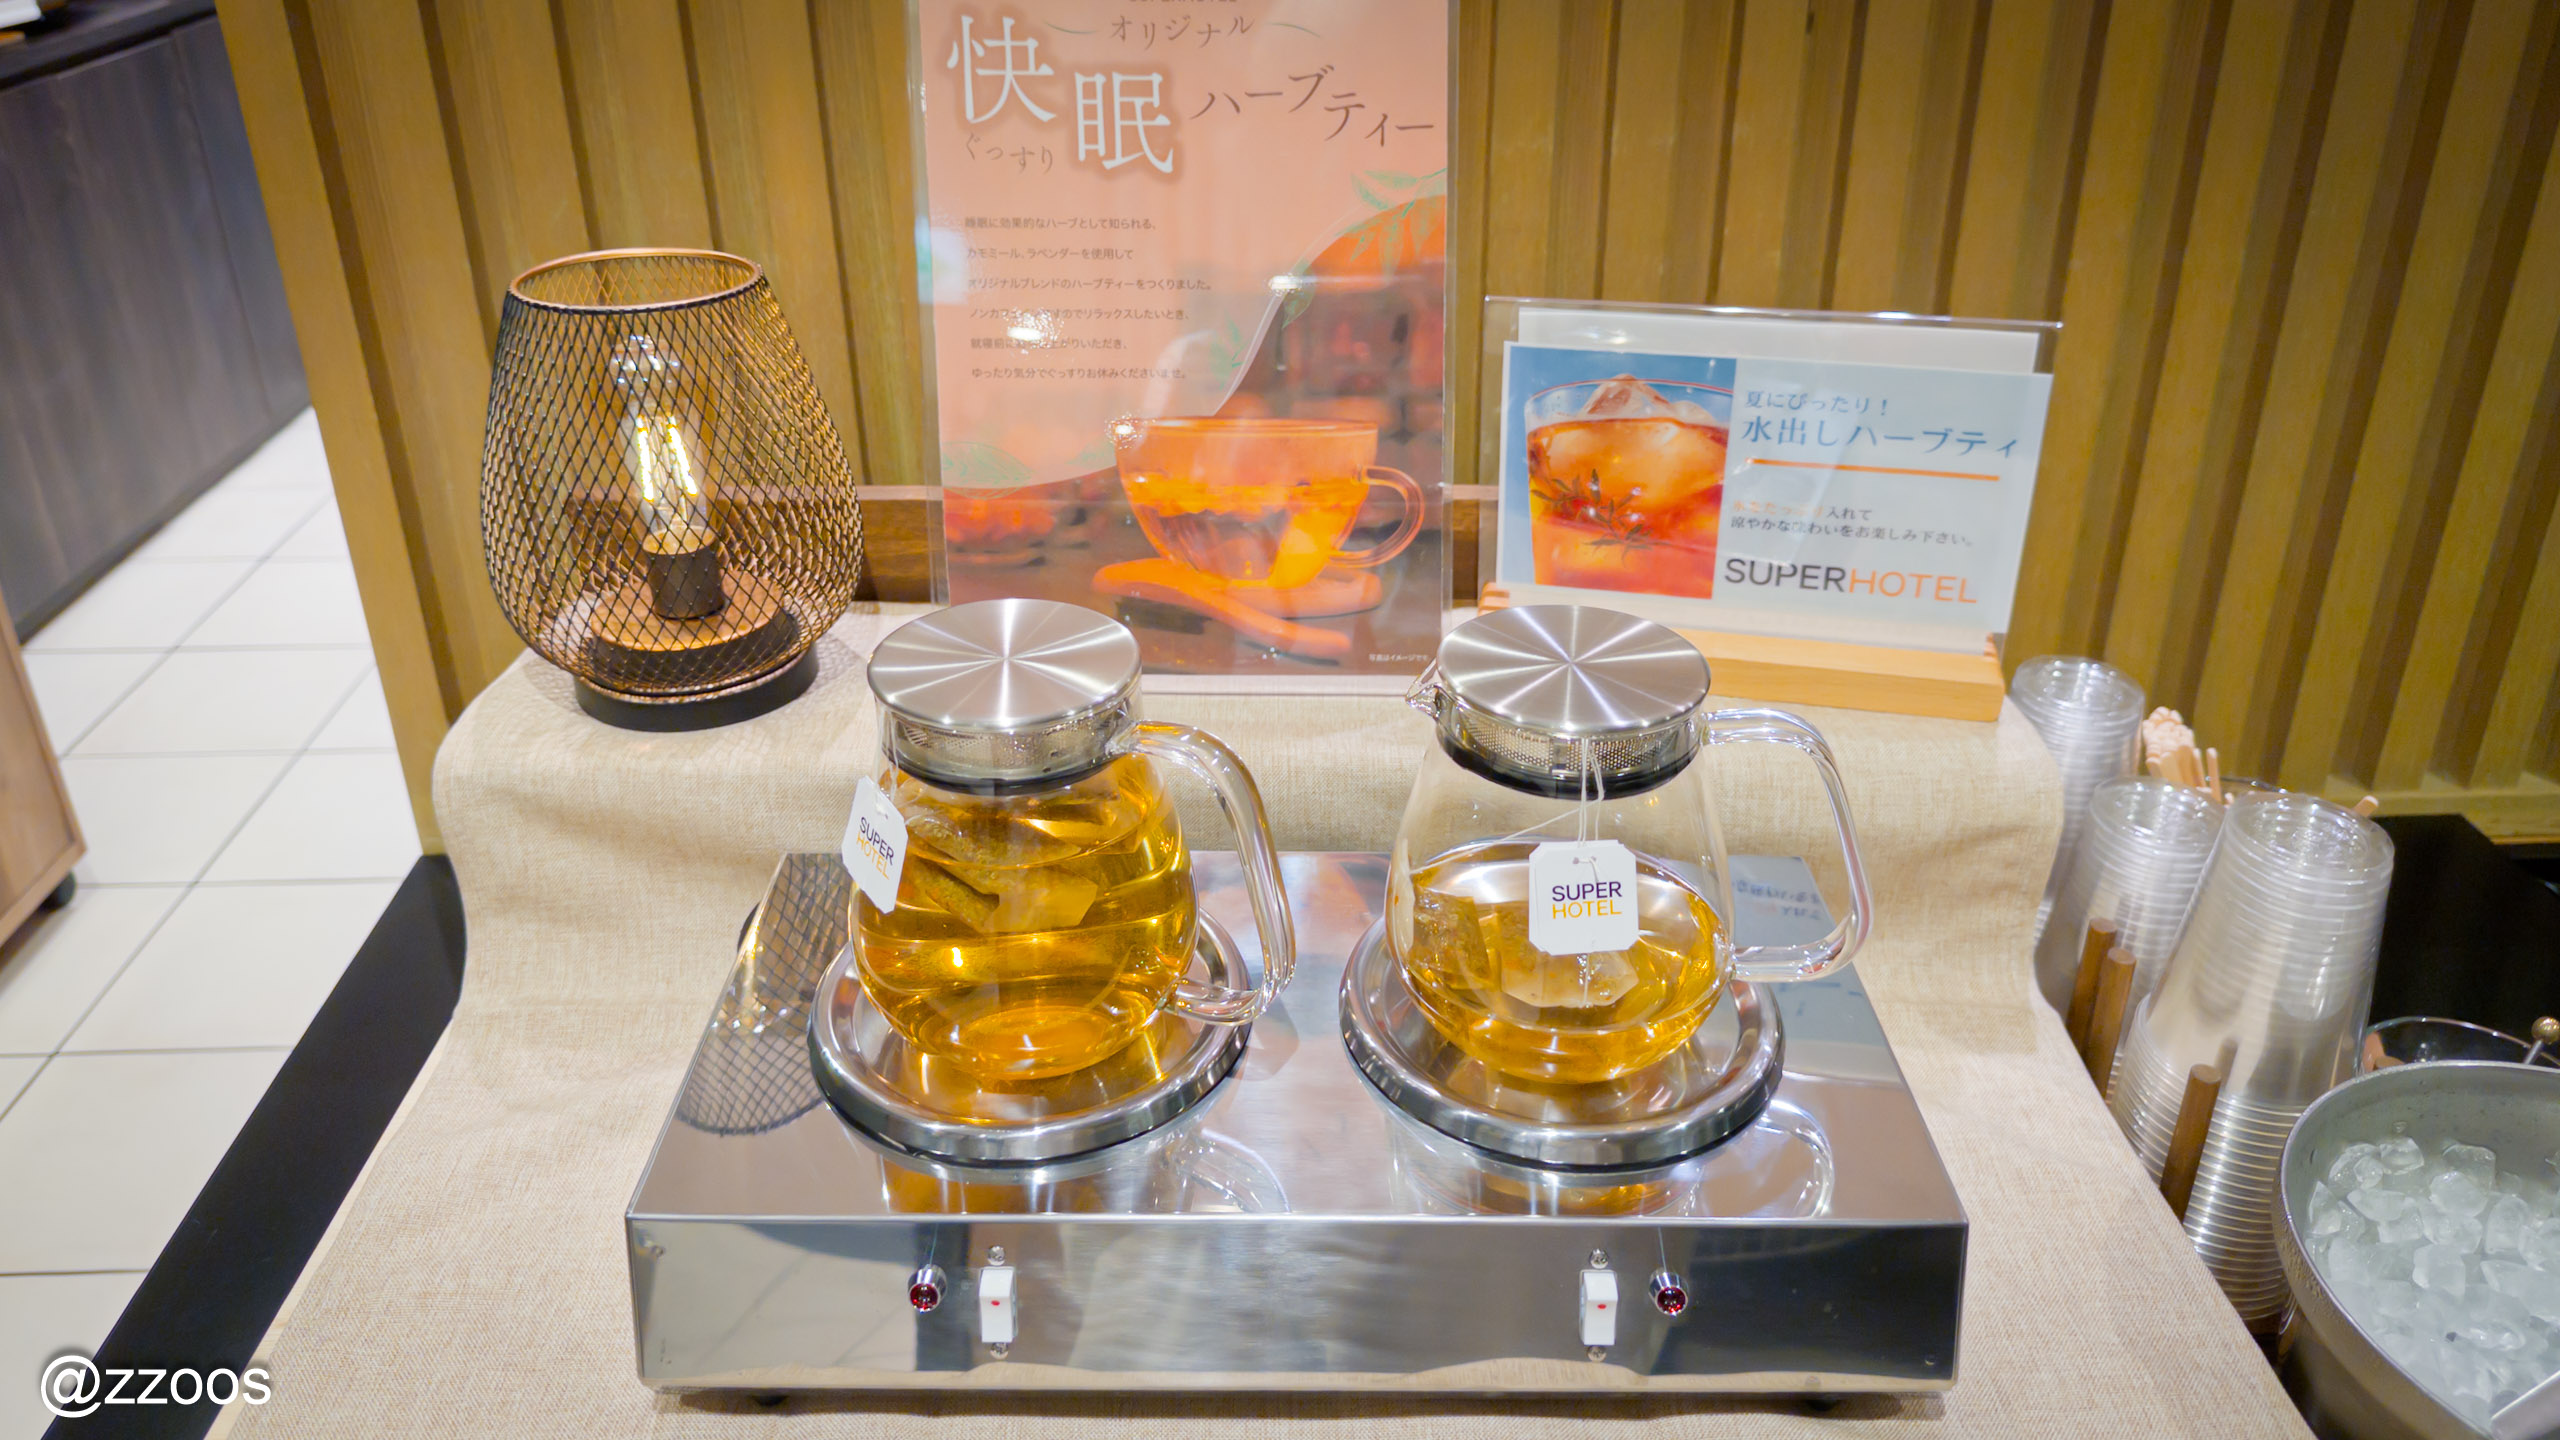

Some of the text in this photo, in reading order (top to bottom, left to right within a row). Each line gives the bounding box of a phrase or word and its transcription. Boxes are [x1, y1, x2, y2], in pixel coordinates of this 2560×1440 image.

[1110, 14, 1255, 50] オリジナル
[947, 15, 1435, 174] 快眠 ハーブティー
[965, 132, 1054, 174] ぐっすり
[970, 308, 1190, 320] ノンカフすのでリラックスしたいとき、
[971, 337, 1128, 350] 就寝前に上がりいただき、
[1745, 390, 1888, 416] 夏にぴったり！
[1742, 415, 2018, 458] 水出しハーブティ
[856, 831, 890, 880] HOTEL
[860, 816, 895, 866] SUPER
[1552, 881, 1623, 902] SUPER
[1552, 899, 1622, 920] HOTEL
